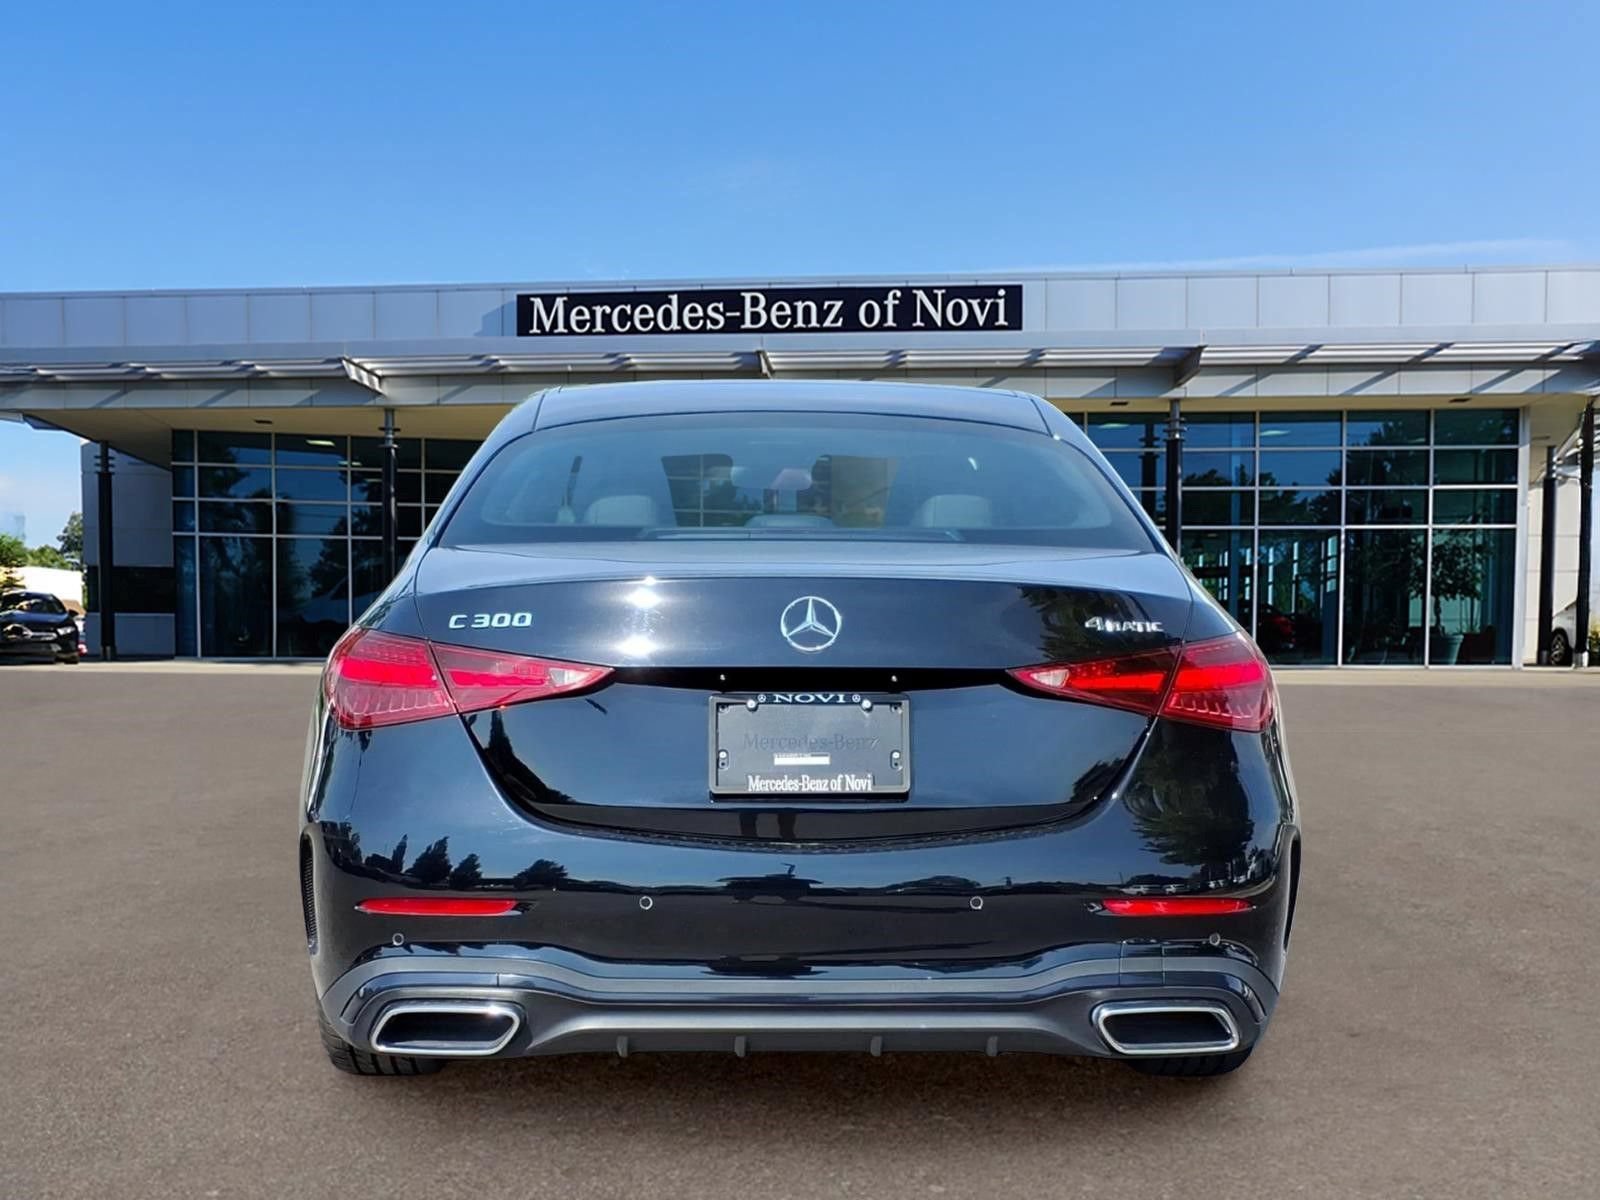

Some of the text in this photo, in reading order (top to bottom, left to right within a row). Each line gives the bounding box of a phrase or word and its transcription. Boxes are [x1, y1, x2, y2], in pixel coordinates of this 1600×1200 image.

[529, 289, 1009, 334] Mercedes-Benz of Novi
[449, 612, 532, 629] C 300
[1084, 616, 1164, 632] 4MATIC
[773, 694, 846, 703] NOVI
[743, 733, 879, 750] Mercedes-Benz
[748, 774, 872, 792] Mercedes-Benz of Novi
